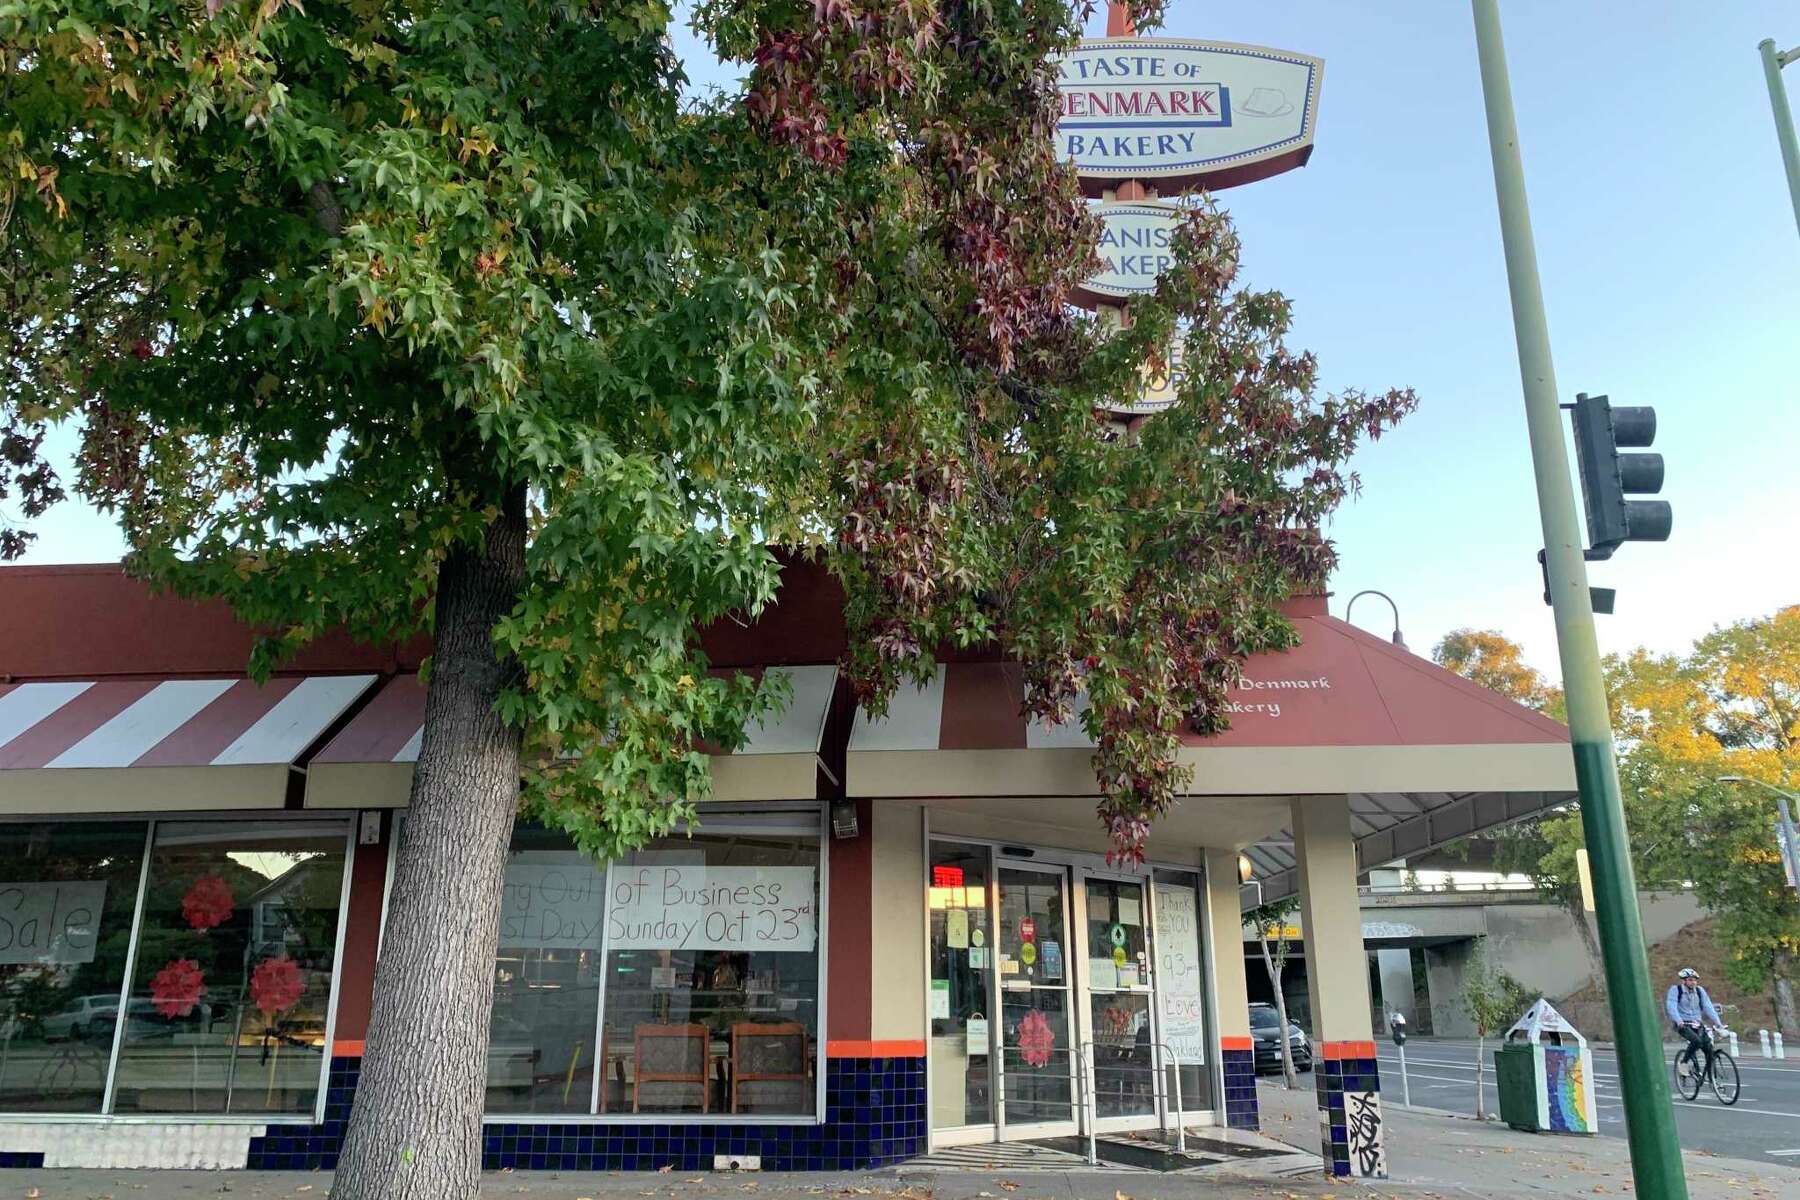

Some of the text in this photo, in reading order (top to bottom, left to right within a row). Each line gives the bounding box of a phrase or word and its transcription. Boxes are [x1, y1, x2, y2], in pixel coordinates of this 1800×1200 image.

[1073, 56, 1165, 79] TASTE
[1173, 62, 1202, 78] OF
[1066, 131, 1196, 157] BAKERY
[1099, 227, 1170, 249] ANIS
[1239, 676, 1331, 691] Denmark
[1222, 701, 1281, 718] akery
[540, 870, 594, 905] Out
[615, 868, 650, 906] of
[662, 868, 783, 906] Business
[540, 907, 602, 946] Day
[607, 906, 699, 949] Sunday
[705, 909, 751, 944] Oct
